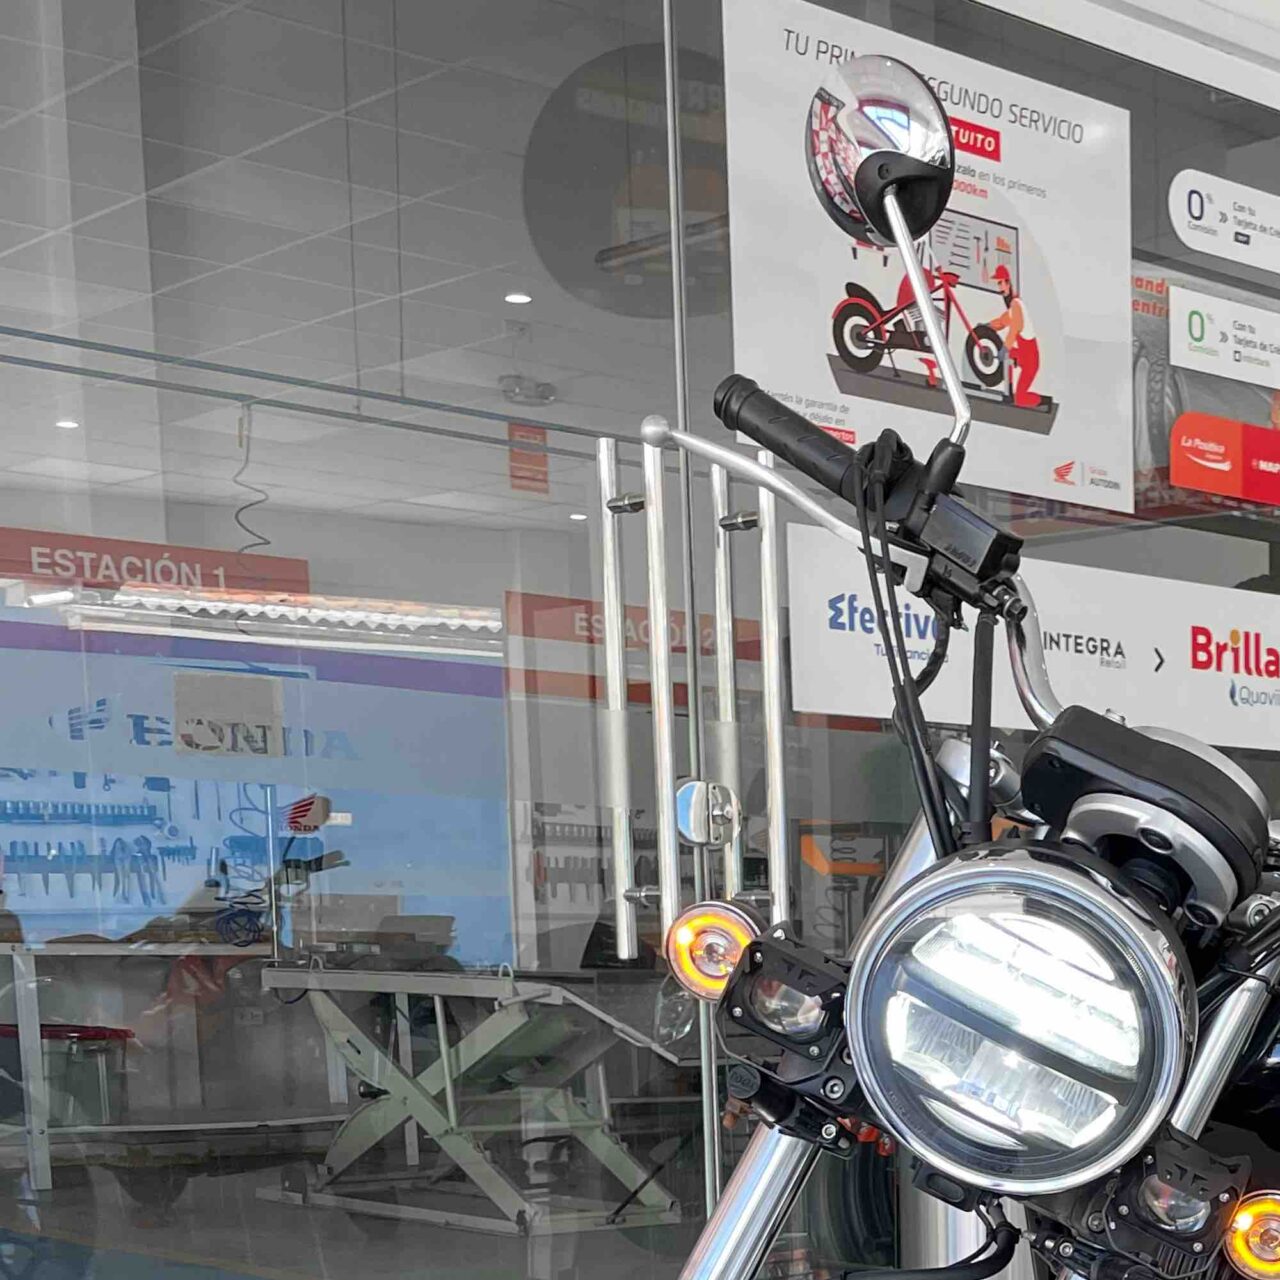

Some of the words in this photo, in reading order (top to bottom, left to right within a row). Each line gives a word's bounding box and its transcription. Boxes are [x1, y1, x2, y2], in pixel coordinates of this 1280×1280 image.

[783, 28, 810, 56] TU
[815, 39, 857, 65] PRI
[921, 73, 1003, 119] EGUNDO
[1008, 103, 1084, 144] SERVICIO
[950, 125, 996, 152] TUITO
[30, 546, 202, 590] ESTACIÓN
[212, 566, 226, 592] 1
[702, 628, 715, 649] 2
[1043, 630, 1126, 659] INTEGRA
[1190, 625, 1280, 679] Brilla
